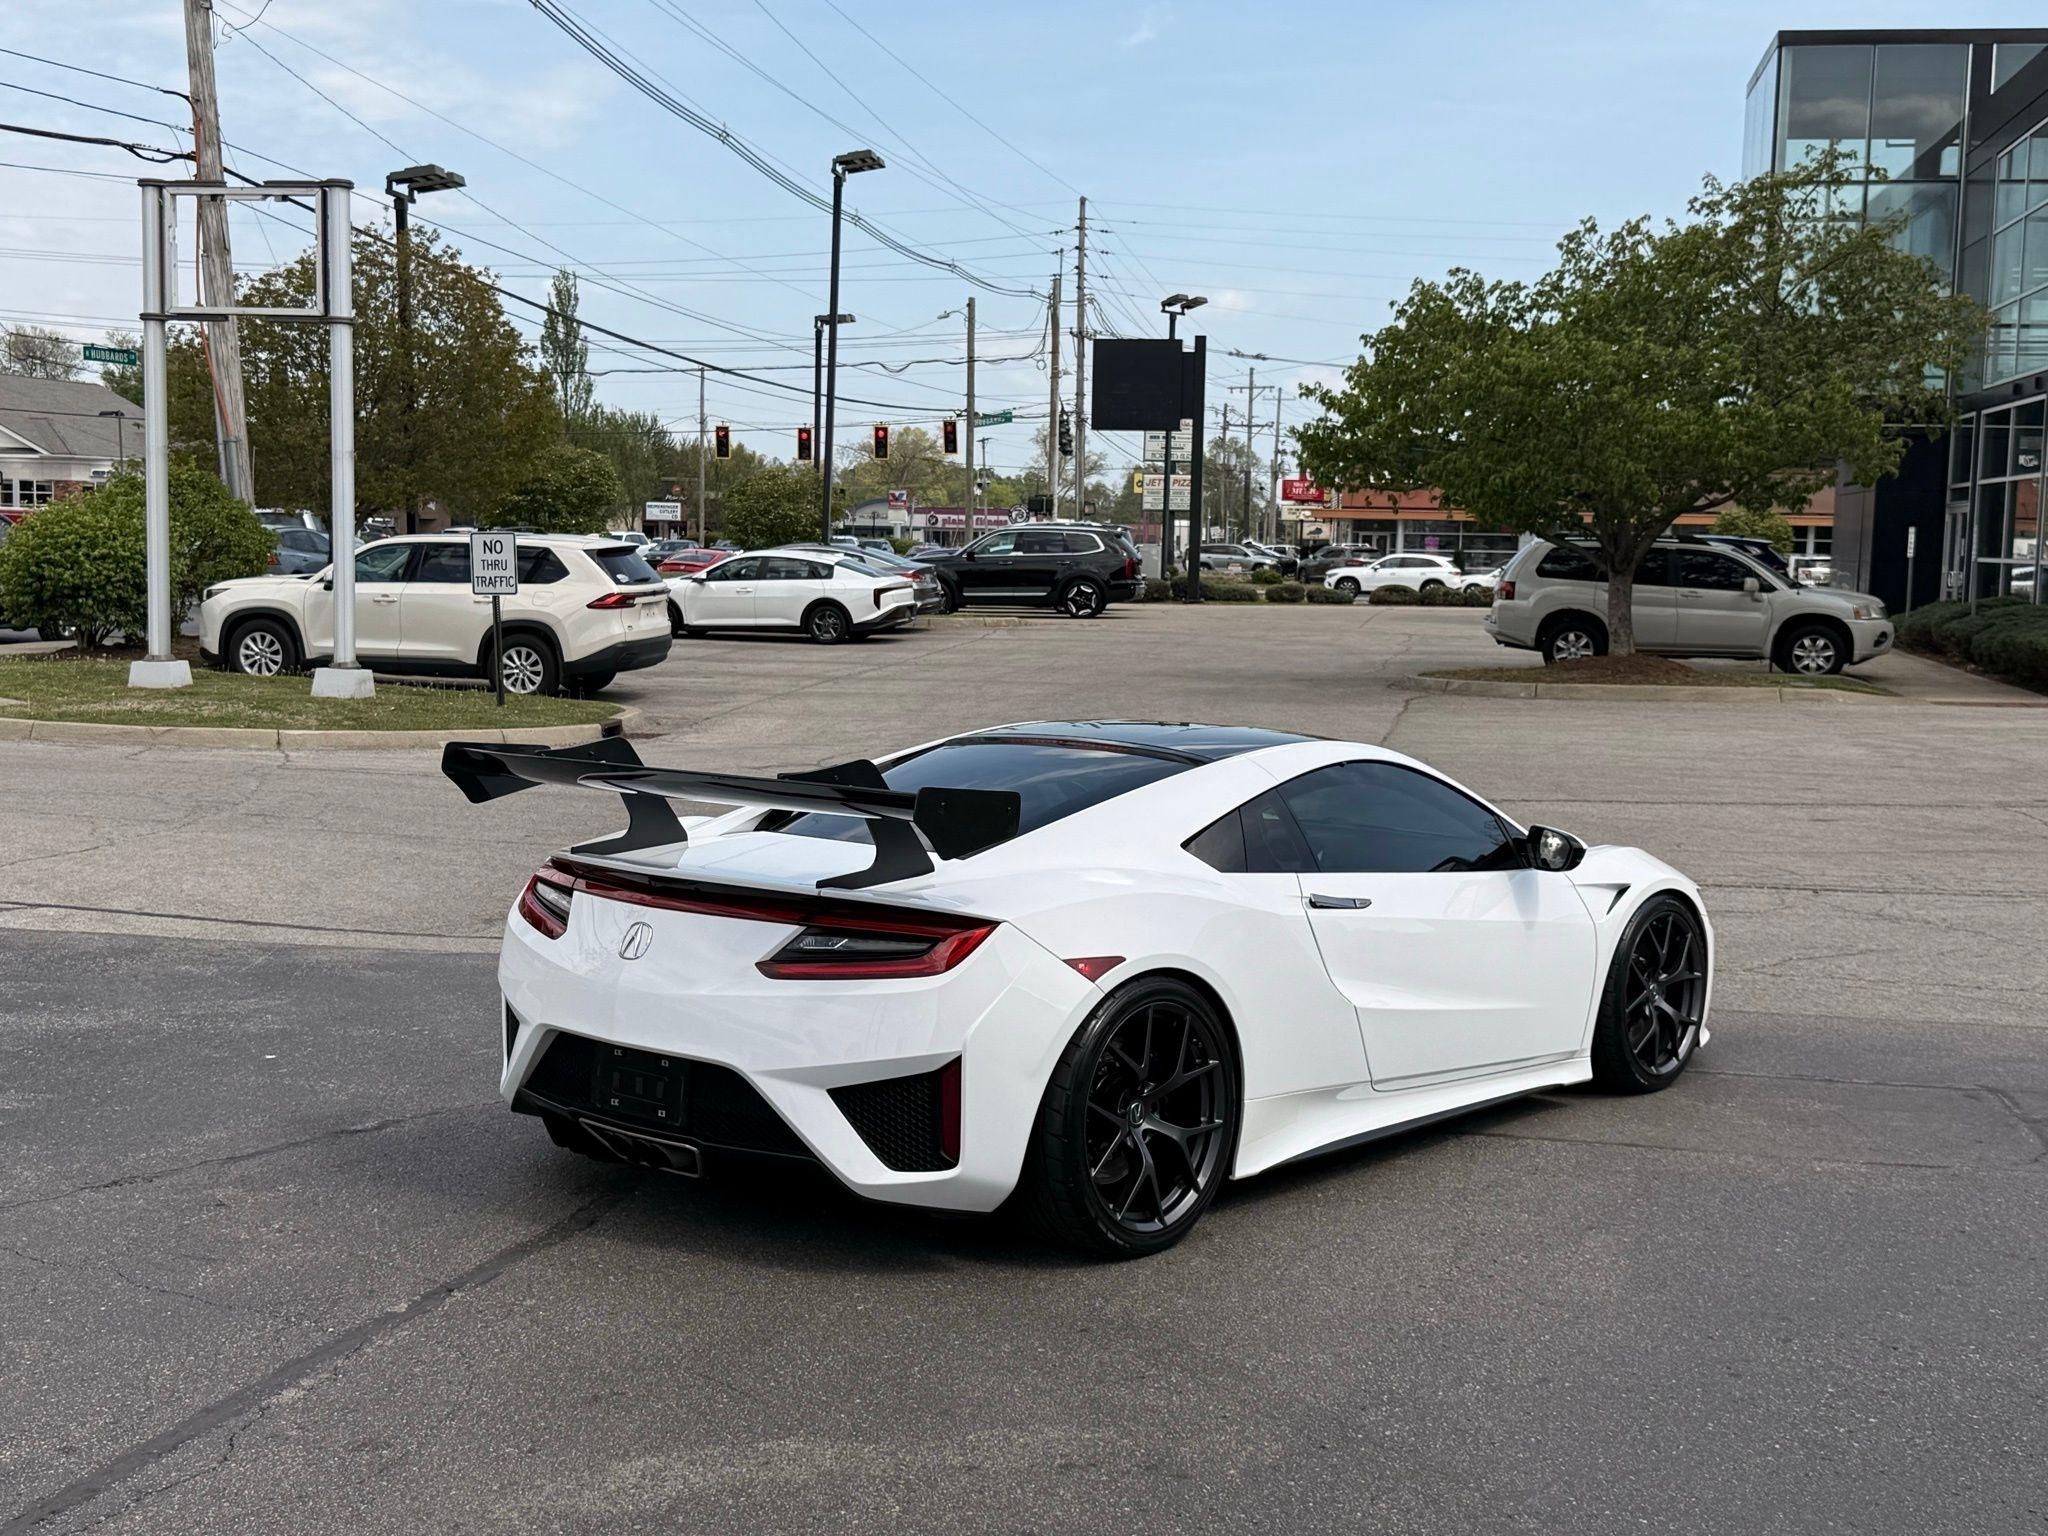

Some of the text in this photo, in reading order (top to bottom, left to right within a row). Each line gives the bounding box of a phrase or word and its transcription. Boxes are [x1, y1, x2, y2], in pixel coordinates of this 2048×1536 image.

[90, 349, 129, 363] HUBBARDS
[1172, 479, 1192, 487] PIZZ
[482, 539, 504, 555] NO
[480, 559, 508, 571] THRU
[475, 575, 515, 588] TRAFFIC
